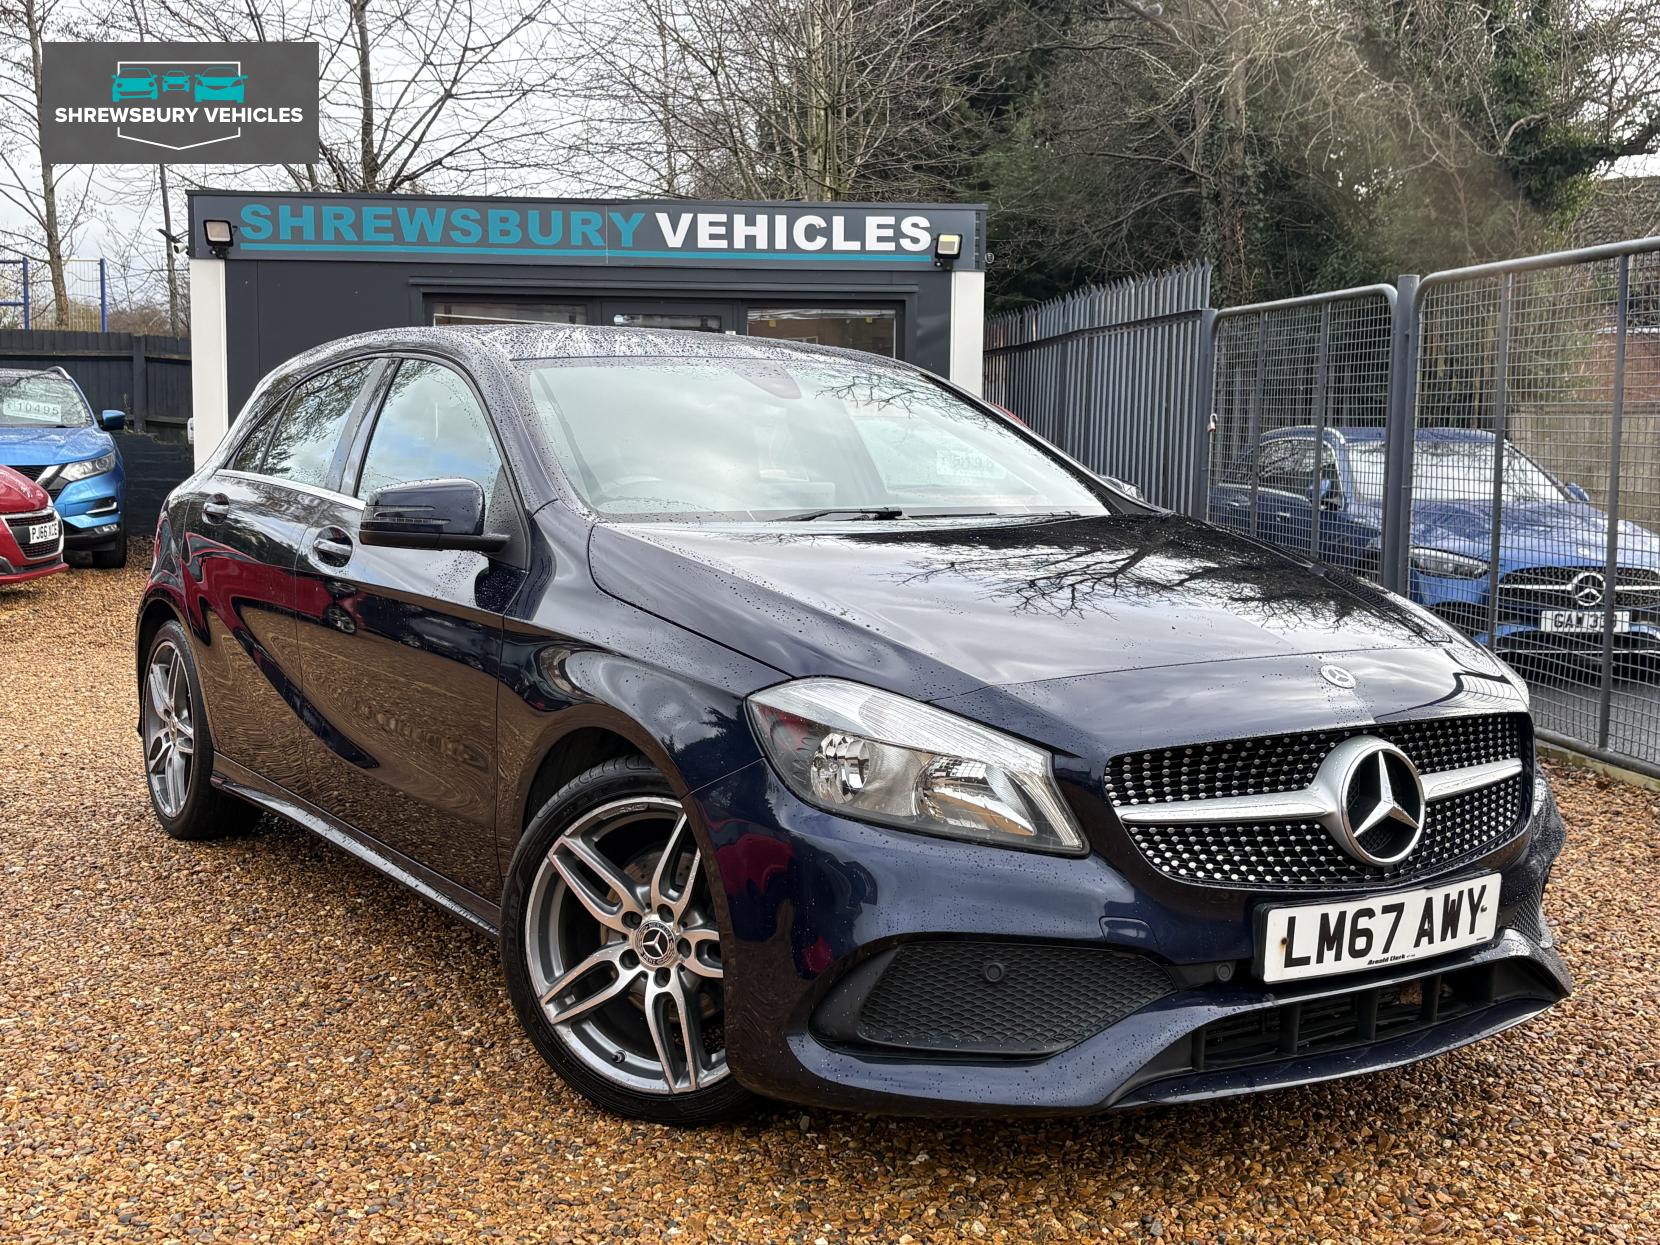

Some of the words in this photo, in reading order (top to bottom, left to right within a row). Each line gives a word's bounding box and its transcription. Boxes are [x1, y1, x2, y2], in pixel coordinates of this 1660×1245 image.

[239, 203, 646, 248] SHREWSBURY
[655, 212, 932, 252] VEHICLES
[1283, 901, 1405, 968] LM67
[1413, 884, 1487, 948] AWY
